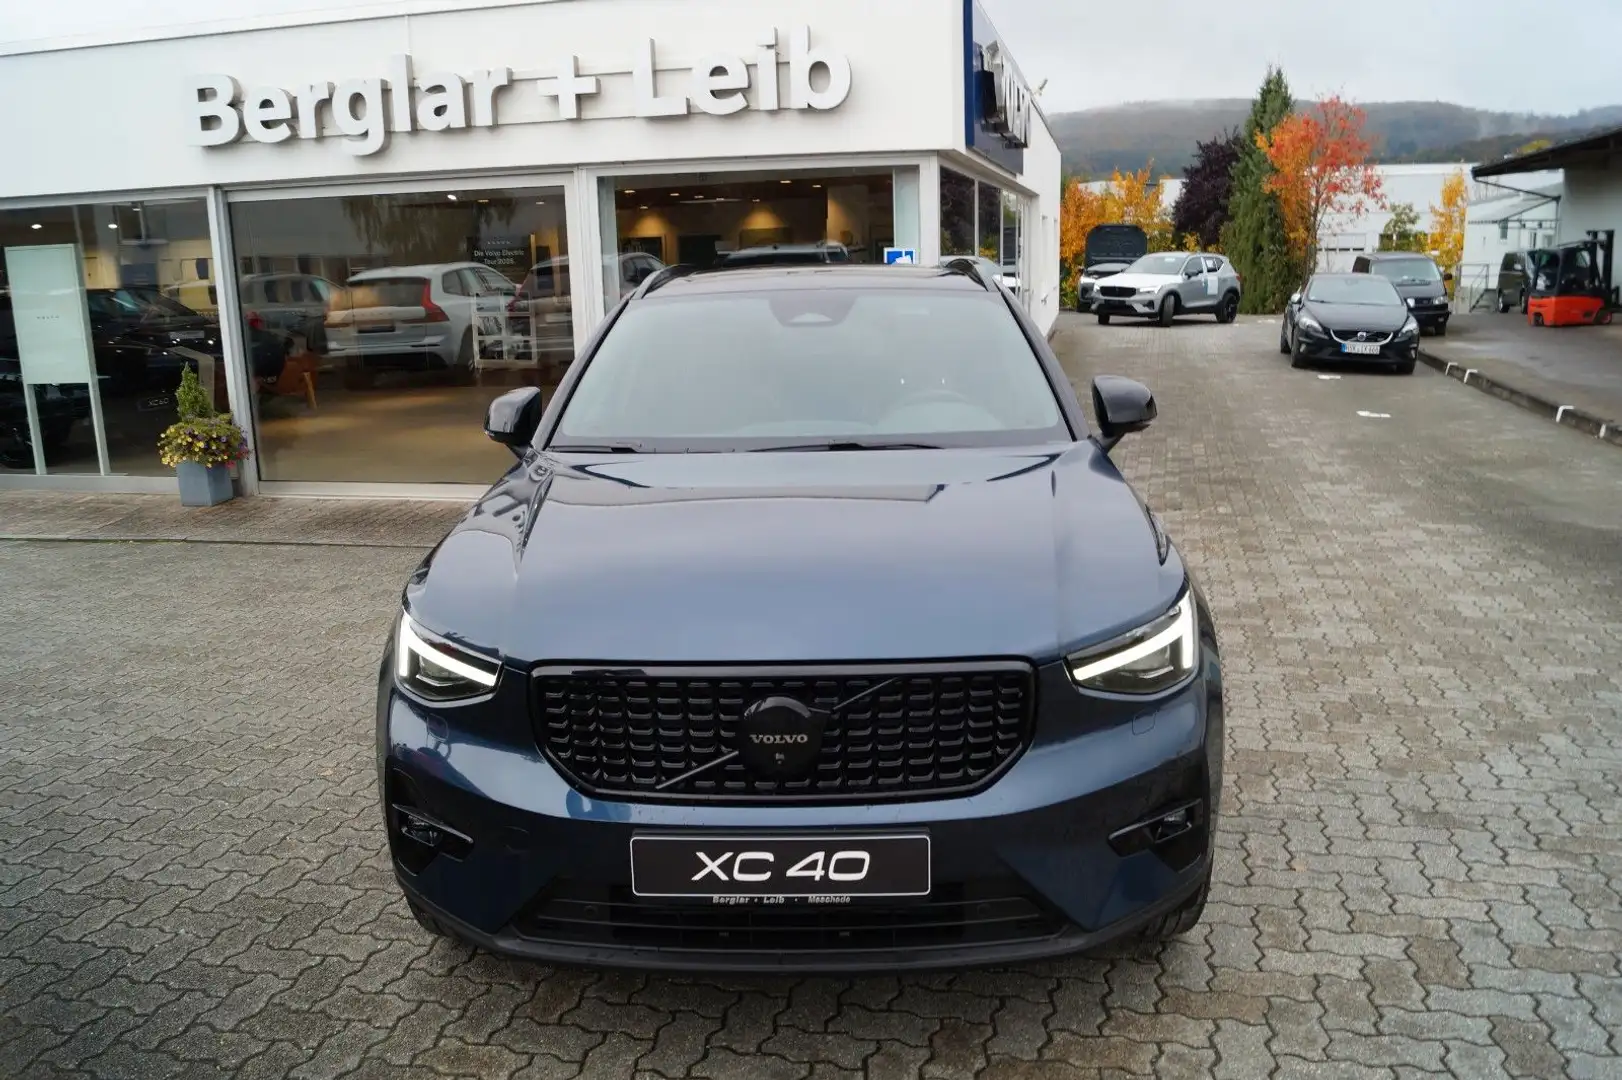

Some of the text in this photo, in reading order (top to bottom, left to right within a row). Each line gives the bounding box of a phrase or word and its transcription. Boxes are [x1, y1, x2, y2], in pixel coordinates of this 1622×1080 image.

[187, 24, 852, 156] Berglar + Leib
[749, 733, 808, 744] VOLVO
[691, 850, 870, 882] XC 40
